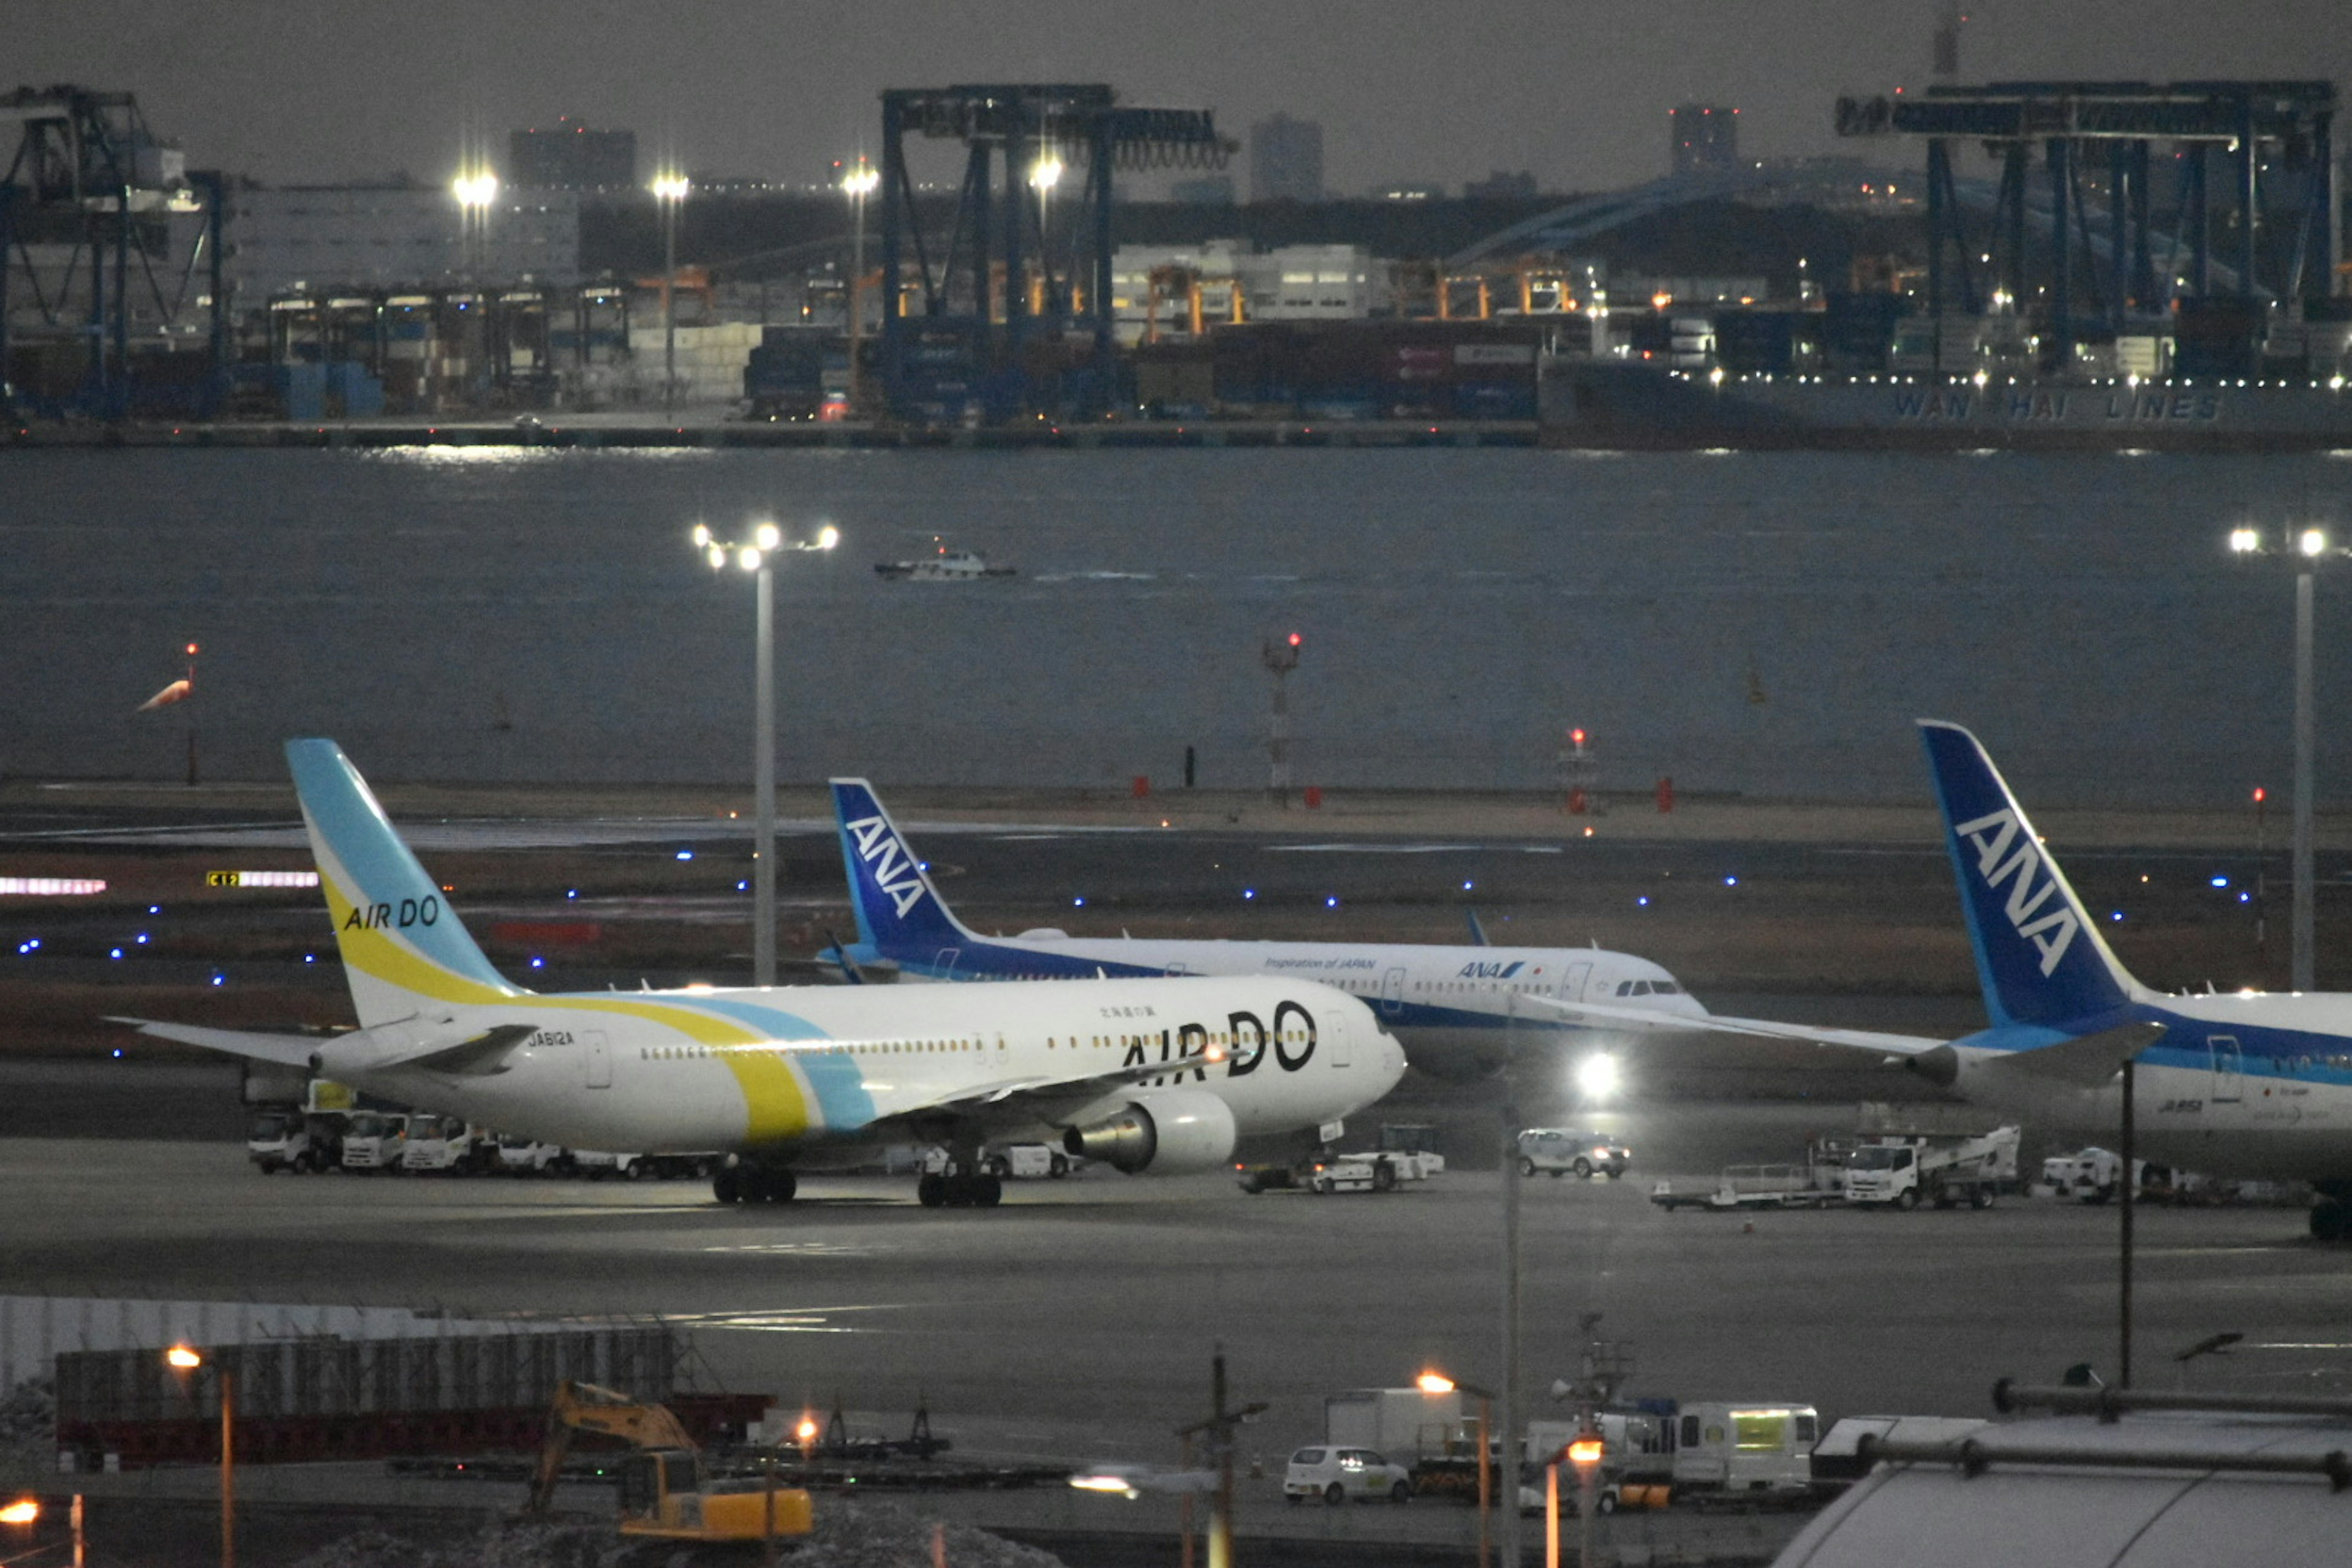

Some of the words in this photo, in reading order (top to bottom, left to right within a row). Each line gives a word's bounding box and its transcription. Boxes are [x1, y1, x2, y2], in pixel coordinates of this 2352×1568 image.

[1894, 390, 1971, 419] WAN
[2009, 391, 2068, 420] HAI
[2106, 393, 2223, 421] LINES
[846, 816, 925, 919] ANA
[1955, 807, 2079, 978] ANA
[344, 903, 391, 930] AIR
[399, 895, 438, 927] DO
[1265, 957, 1322, 968] Inspiration
[1325, 957, 1339, 968] of
[1338, 959, 1377, 969] JAPAN
[1457, 962, 1502, 978] ANA
[1123, 1022, 1207, 1086] AIR
[1228, 1000, 1317, 1077] DO
